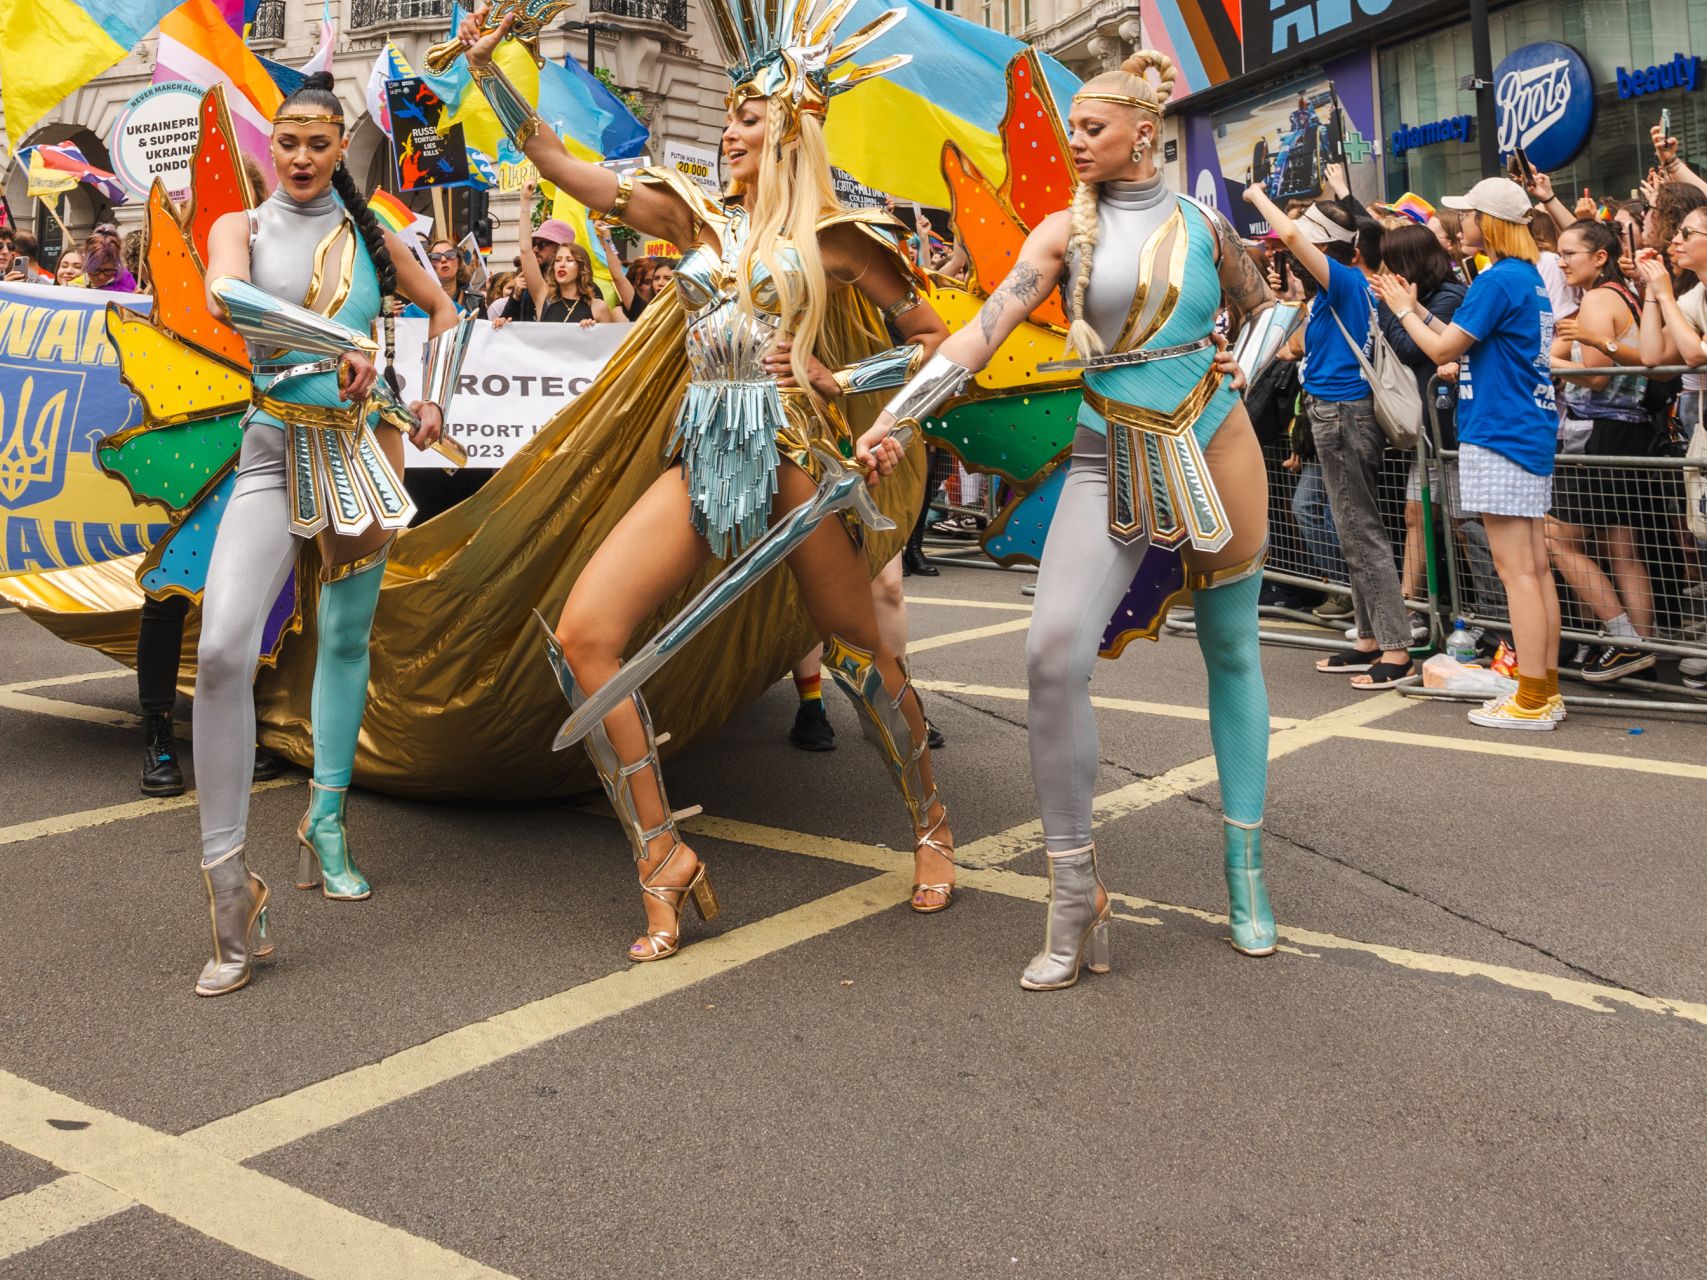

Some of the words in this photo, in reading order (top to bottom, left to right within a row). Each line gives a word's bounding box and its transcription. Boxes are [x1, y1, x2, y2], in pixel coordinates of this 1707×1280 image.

[308, 39, 386, 57] AIANCE
[1616, 52, 1701, 100] beauty
[130, 89, 154, 108] NEVER
[154, 83, 183, 94] MARCH
[1496, 58, 1572, 154] Boots
[126, 117, 198, 136] UKRAINEPRI
[412, 126, 437, 137] RUSSI
[138, 138, 147, 147] &
[150, 130, 200, 145] SUPPOR
[1391, 114, 1473, 157] pharmacy
[422, 149, 439, 157] KILLS
[423, 142, 437, 150] LIES
[670, 151, 686, 160] PUTIN
[149, 160, 188, 173] LONDO
[678, 161, 689, 173] 20
[691, 164, 707, 177] 000
[647, 243, 664, 257] HOT
[455, 374, 594, 397] ROTEC
[446, 423, 524, 437] PPORT
[467, 444, 505, 458] 023
